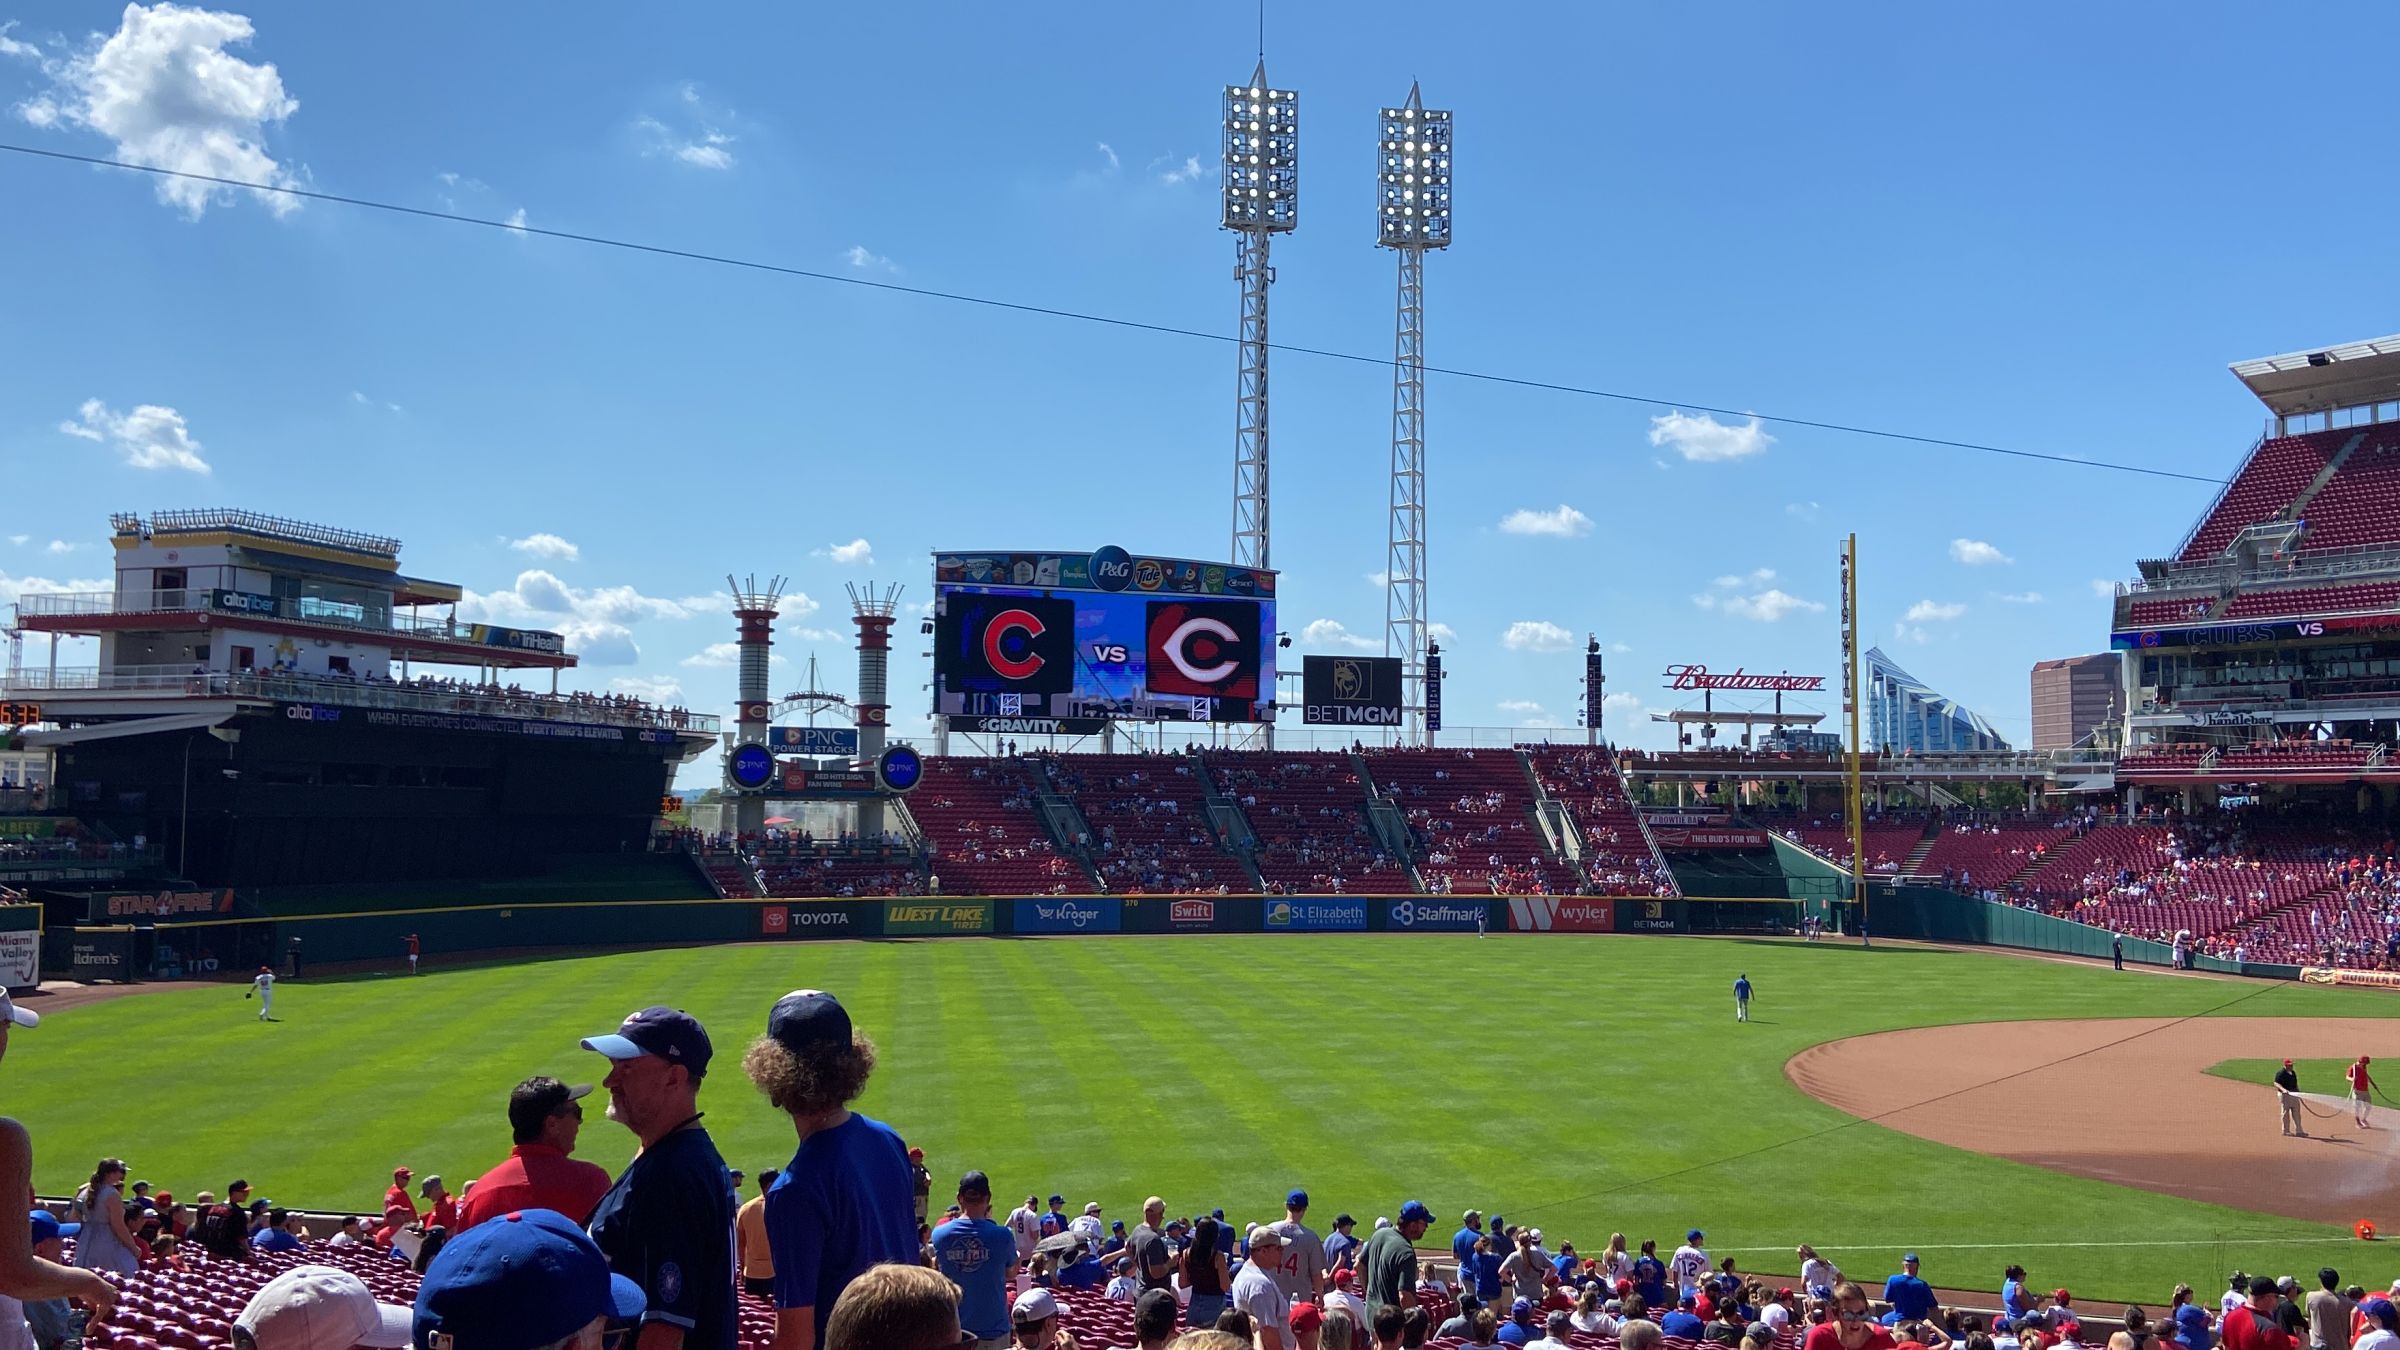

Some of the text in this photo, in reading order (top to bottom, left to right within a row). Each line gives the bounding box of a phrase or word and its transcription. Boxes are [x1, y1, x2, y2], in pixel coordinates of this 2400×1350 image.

[1099, 561, 1131, 577] P&G
[1136, 566, 1161, 585] Tide
[223, 591, 274, 611] altafiber
[2186, 623, 2276, 646] CUBS
[2296, 622, 2324, 635] VS
[521, 632, 564, 651] TriHealth
[1093, 645, 1126, 662] VS
[1667, 664, 1822, 690] Budweiser
[287, 704, 341, 722] altafiber
[1307, 705, 1398, 723] BETMGM
[2208, 713, 2273, 725] handlebar
[367, 711, 399, 725] WHEN
[402, 714, 460, 729] EVERYONE'S
[522, 721, 582, 737] EVERYTHING'S
[987, 718, 1061, 734] GRAVITY
[805, 728, 845, 746] PNC
[772, 744, 855, 754] POWER STACKS
[747, 761, 768, 769] PNC
[896, 763, 915, 772] PNC
[1691, 835, 1707, 843] THIS
[1708, 834, 1730, 843] BUD'S
[1730, 835, 1745, 843] FOR
[1882, 888, 1896, 896] 325
[107, 892, 213, 916] STAR FIRE
[1125, 899, 1139, 907] 370
[792, 912, 849, 925] TOYOTA
[889, 906, 985, 922] WEST LAKE
[1056, 901, 1099, 927] Kroger
[1174, 904, 1210, 918] Swift
[1307, 906, 1363, 919] Elizabeth
[1417, 906, 1484, 921] Staffmark
[1561, 904, 1608, 924] wyler
[952, 921, 982, 929] TIRES
[1633, 920, 1674, 929] BETMGM
[0, 934, 33, 945] Miami
[1, 946, 35, 960] Valley
[1682, 1260, 1698, 1277] 12
[1111, 1286, 1126, 1301] 20
